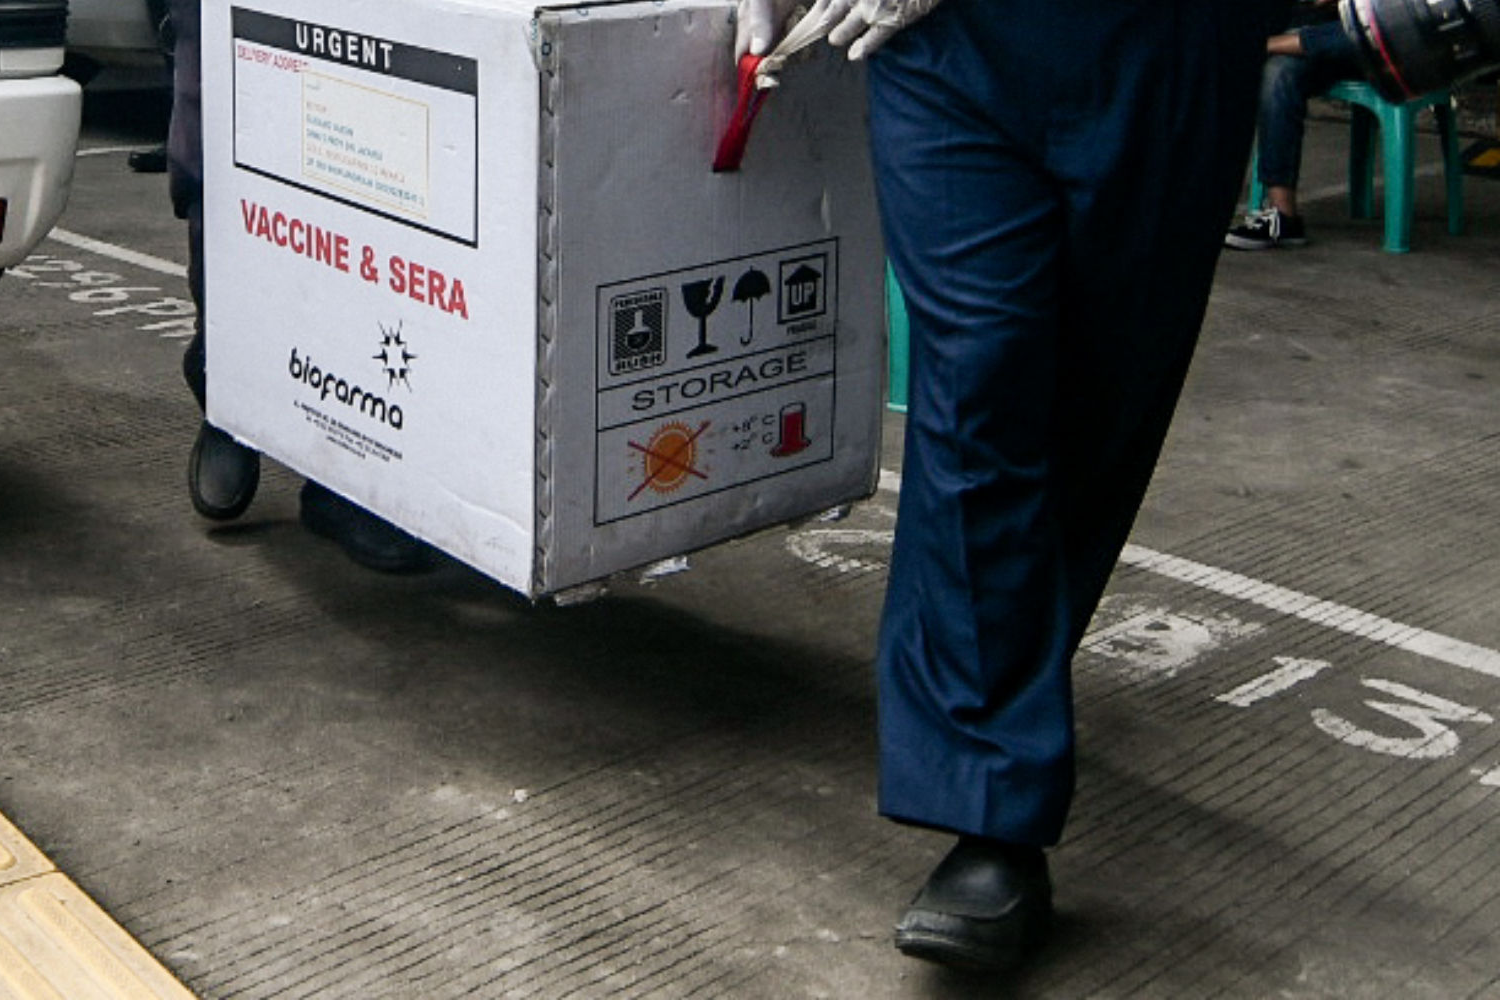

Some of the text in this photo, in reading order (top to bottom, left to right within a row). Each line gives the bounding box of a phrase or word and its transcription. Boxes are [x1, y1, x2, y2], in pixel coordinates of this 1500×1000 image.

[295, 22, 394, 70] URGENT
[240, 199, 469, 320] VACCINE & SERA
[794, 283, 815, 306] UP
[288, 346, 404, 430] biofarma
[631, 352, 808, 411] STORAGE
